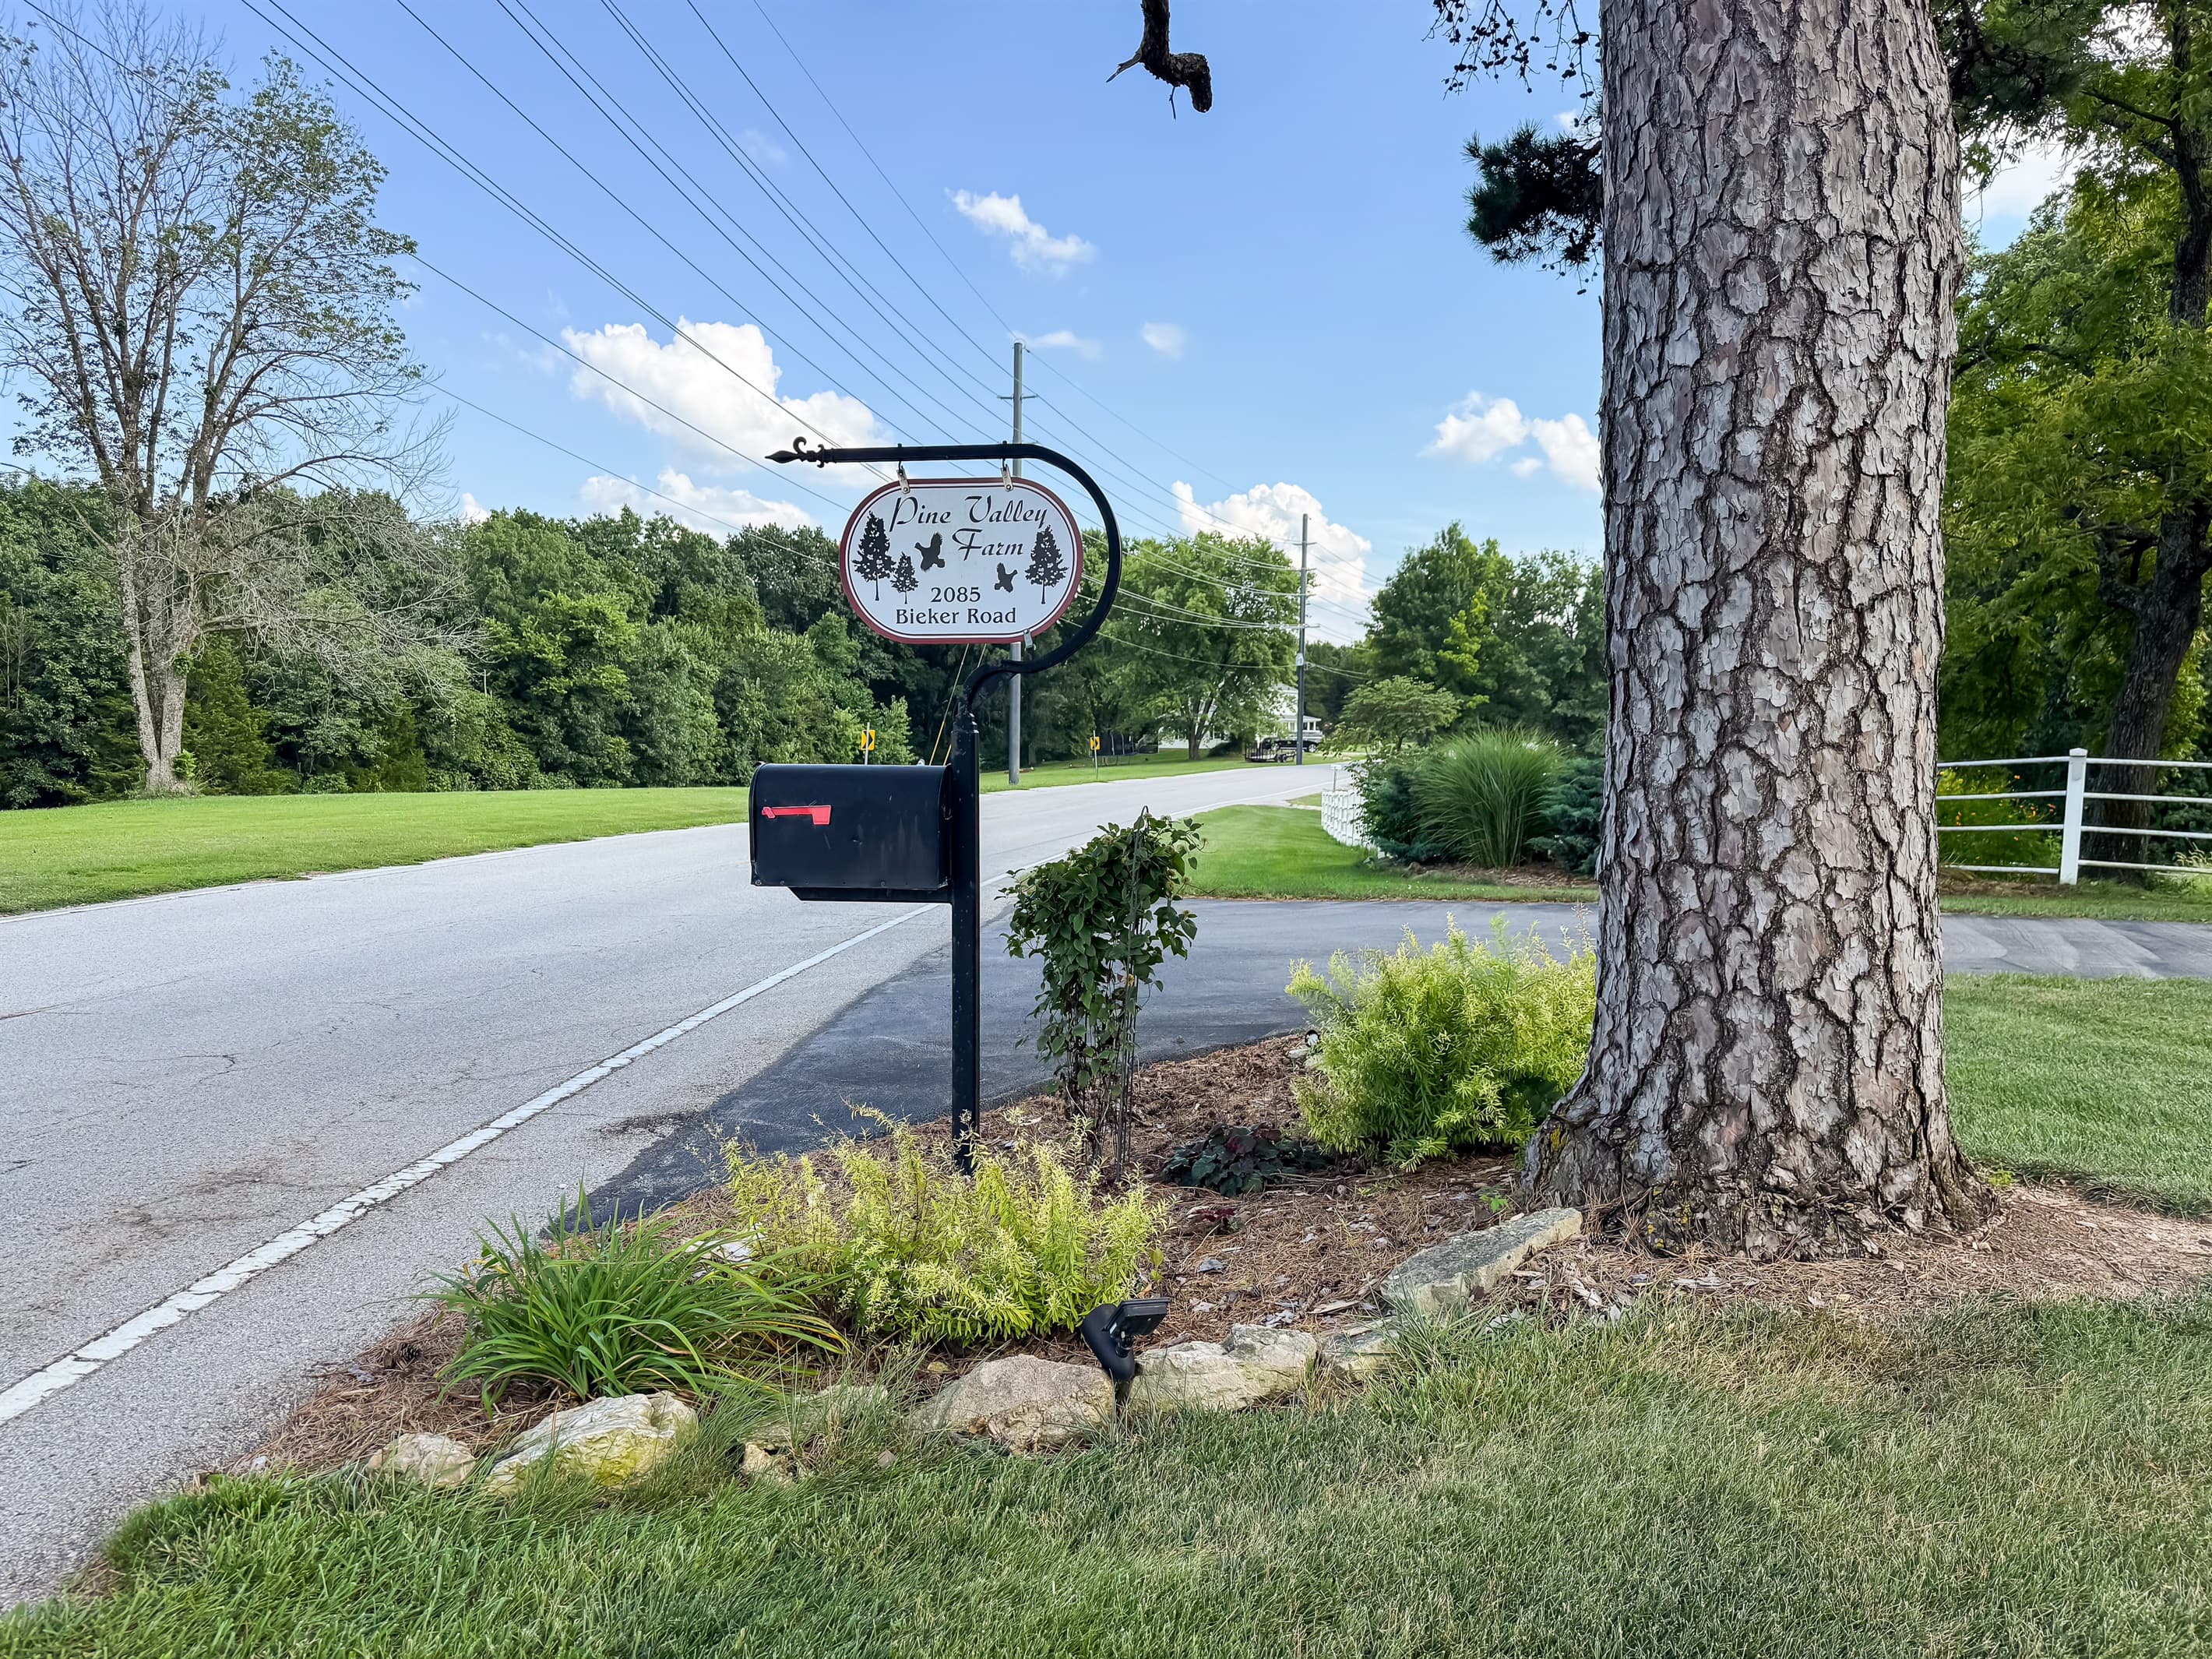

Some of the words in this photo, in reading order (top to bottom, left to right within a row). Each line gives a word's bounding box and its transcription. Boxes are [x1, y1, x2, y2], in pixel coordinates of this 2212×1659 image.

[889, 496, 952, 532] Pine
[964, 495, 1048, 528] Valley
[952, 528, 1024, 561] Farm
[931, 586, 981, 603] 2085
[896, 608, 960, 624] Bieker
[967, 608, 1016, 623] Road
